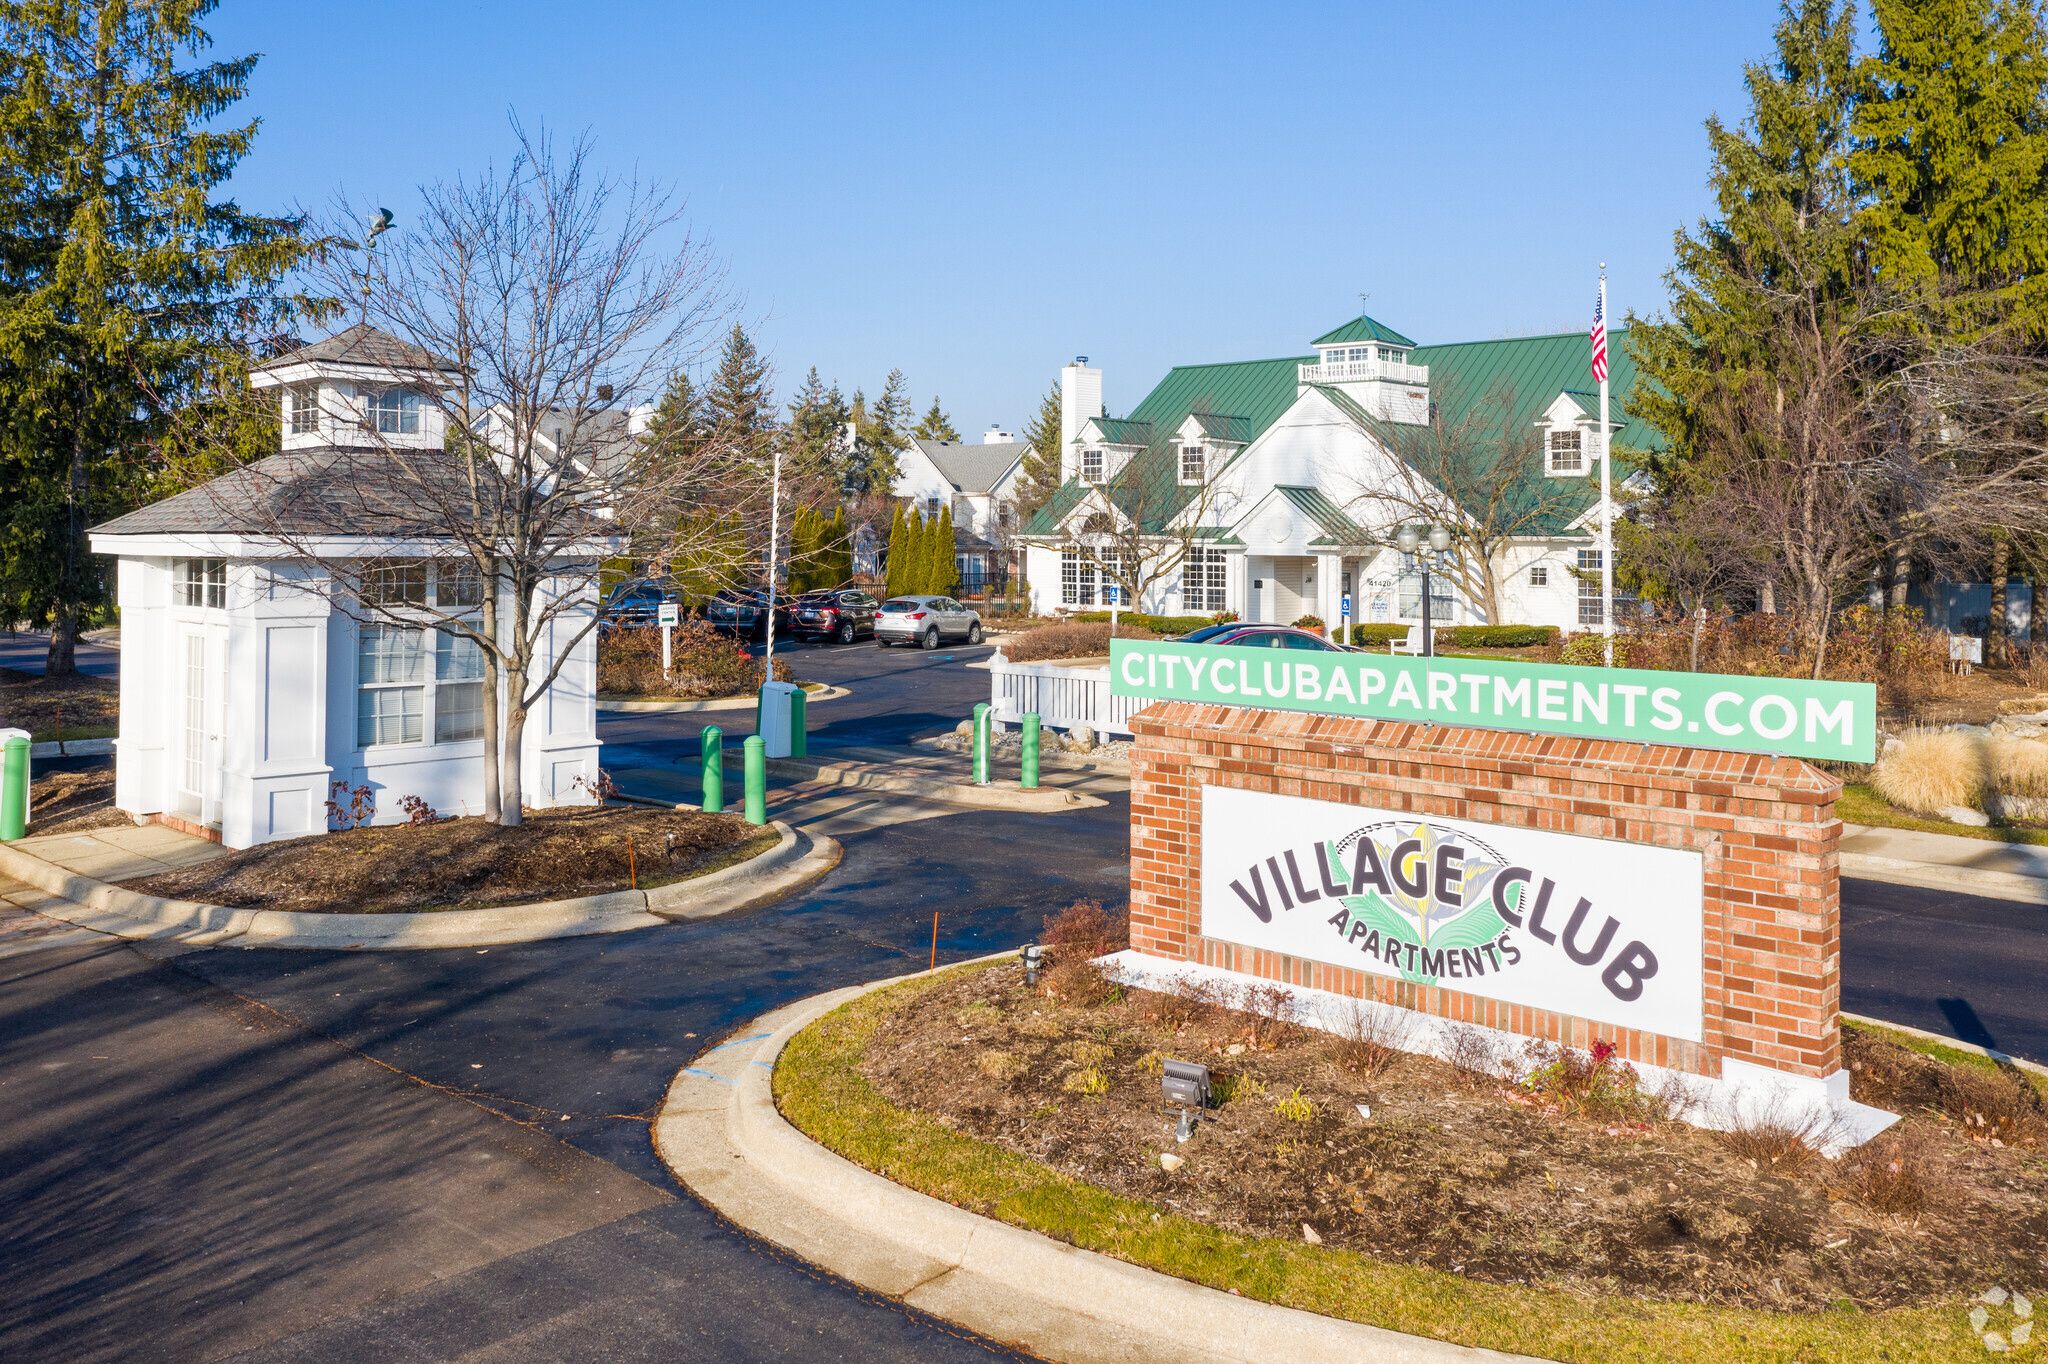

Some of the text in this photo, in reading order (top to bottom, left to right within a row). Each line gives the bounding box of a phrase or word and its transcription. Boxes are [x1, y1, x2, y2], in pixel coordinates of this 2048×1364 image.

[1121, 652, 1853, 745] CITYCLUBAPARTMENTS.COM
[1229, 836, 1659, 1002] VILLAGE CLUB
[1327, 908, 1521, 978] APARTMENTS
